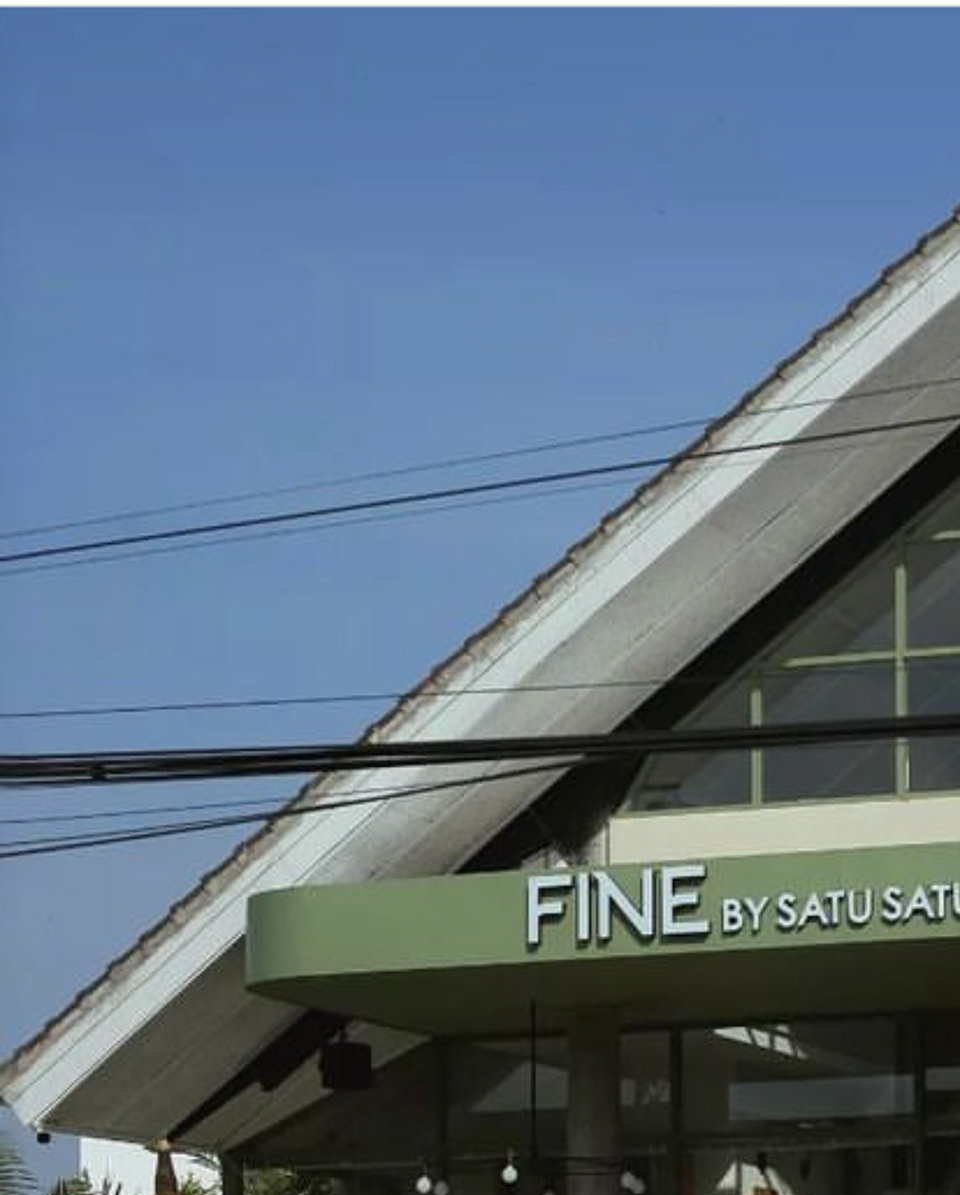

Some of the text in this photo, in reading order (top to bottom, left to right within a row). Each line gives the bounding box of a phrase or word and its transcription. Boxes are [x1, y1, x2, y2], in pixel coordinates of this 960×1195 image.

[526, 862, 712, 948] FINE
[720, 896, 769, 935] BY
[776, 888, 874, 929] SATU
